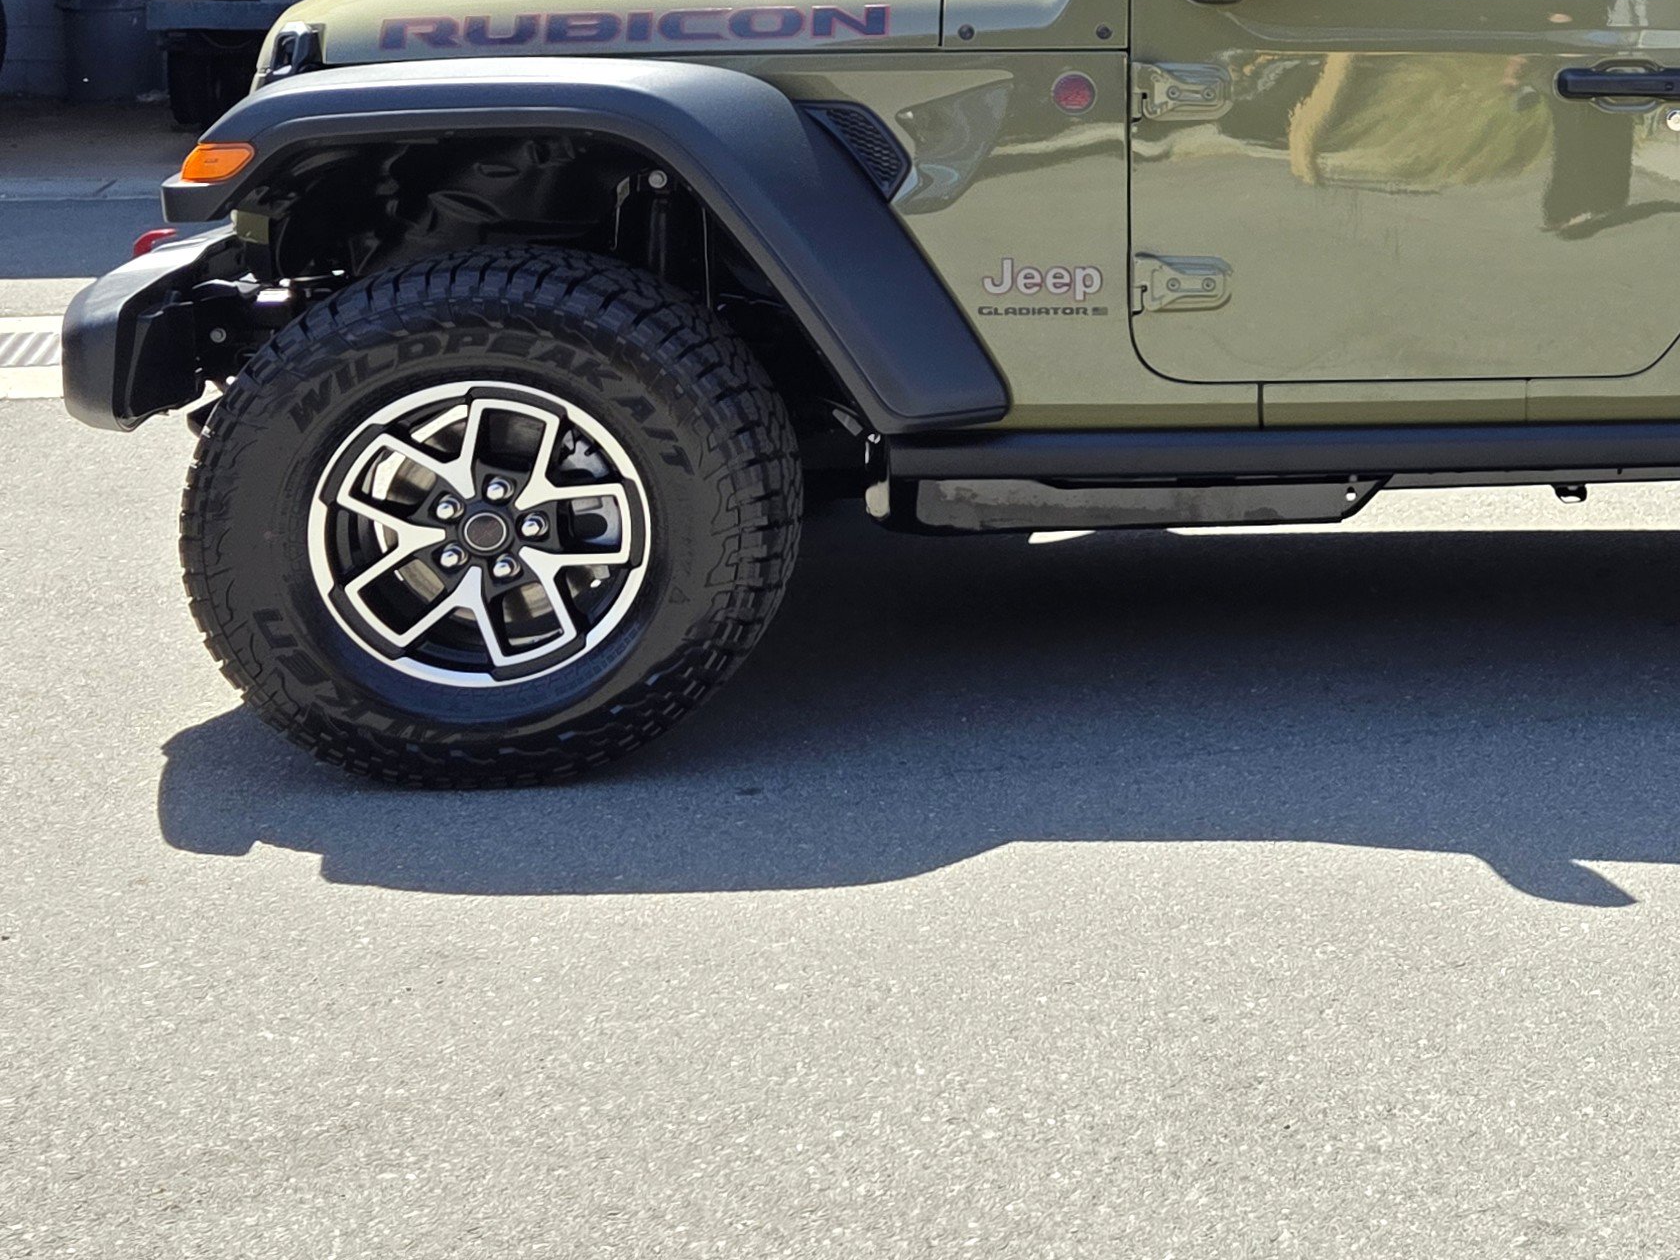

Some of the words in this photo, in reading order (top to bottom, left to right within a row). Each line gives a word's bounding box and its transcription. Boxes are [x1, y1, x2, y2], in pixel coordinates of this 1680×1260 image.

[378, 4, 890, 50] RUBICON
[982, 257, 1104, 302] Jeep
[977, 306, 1090, 316] GLADIATOR
[286, 325, 623, 434] WILDPEAK
